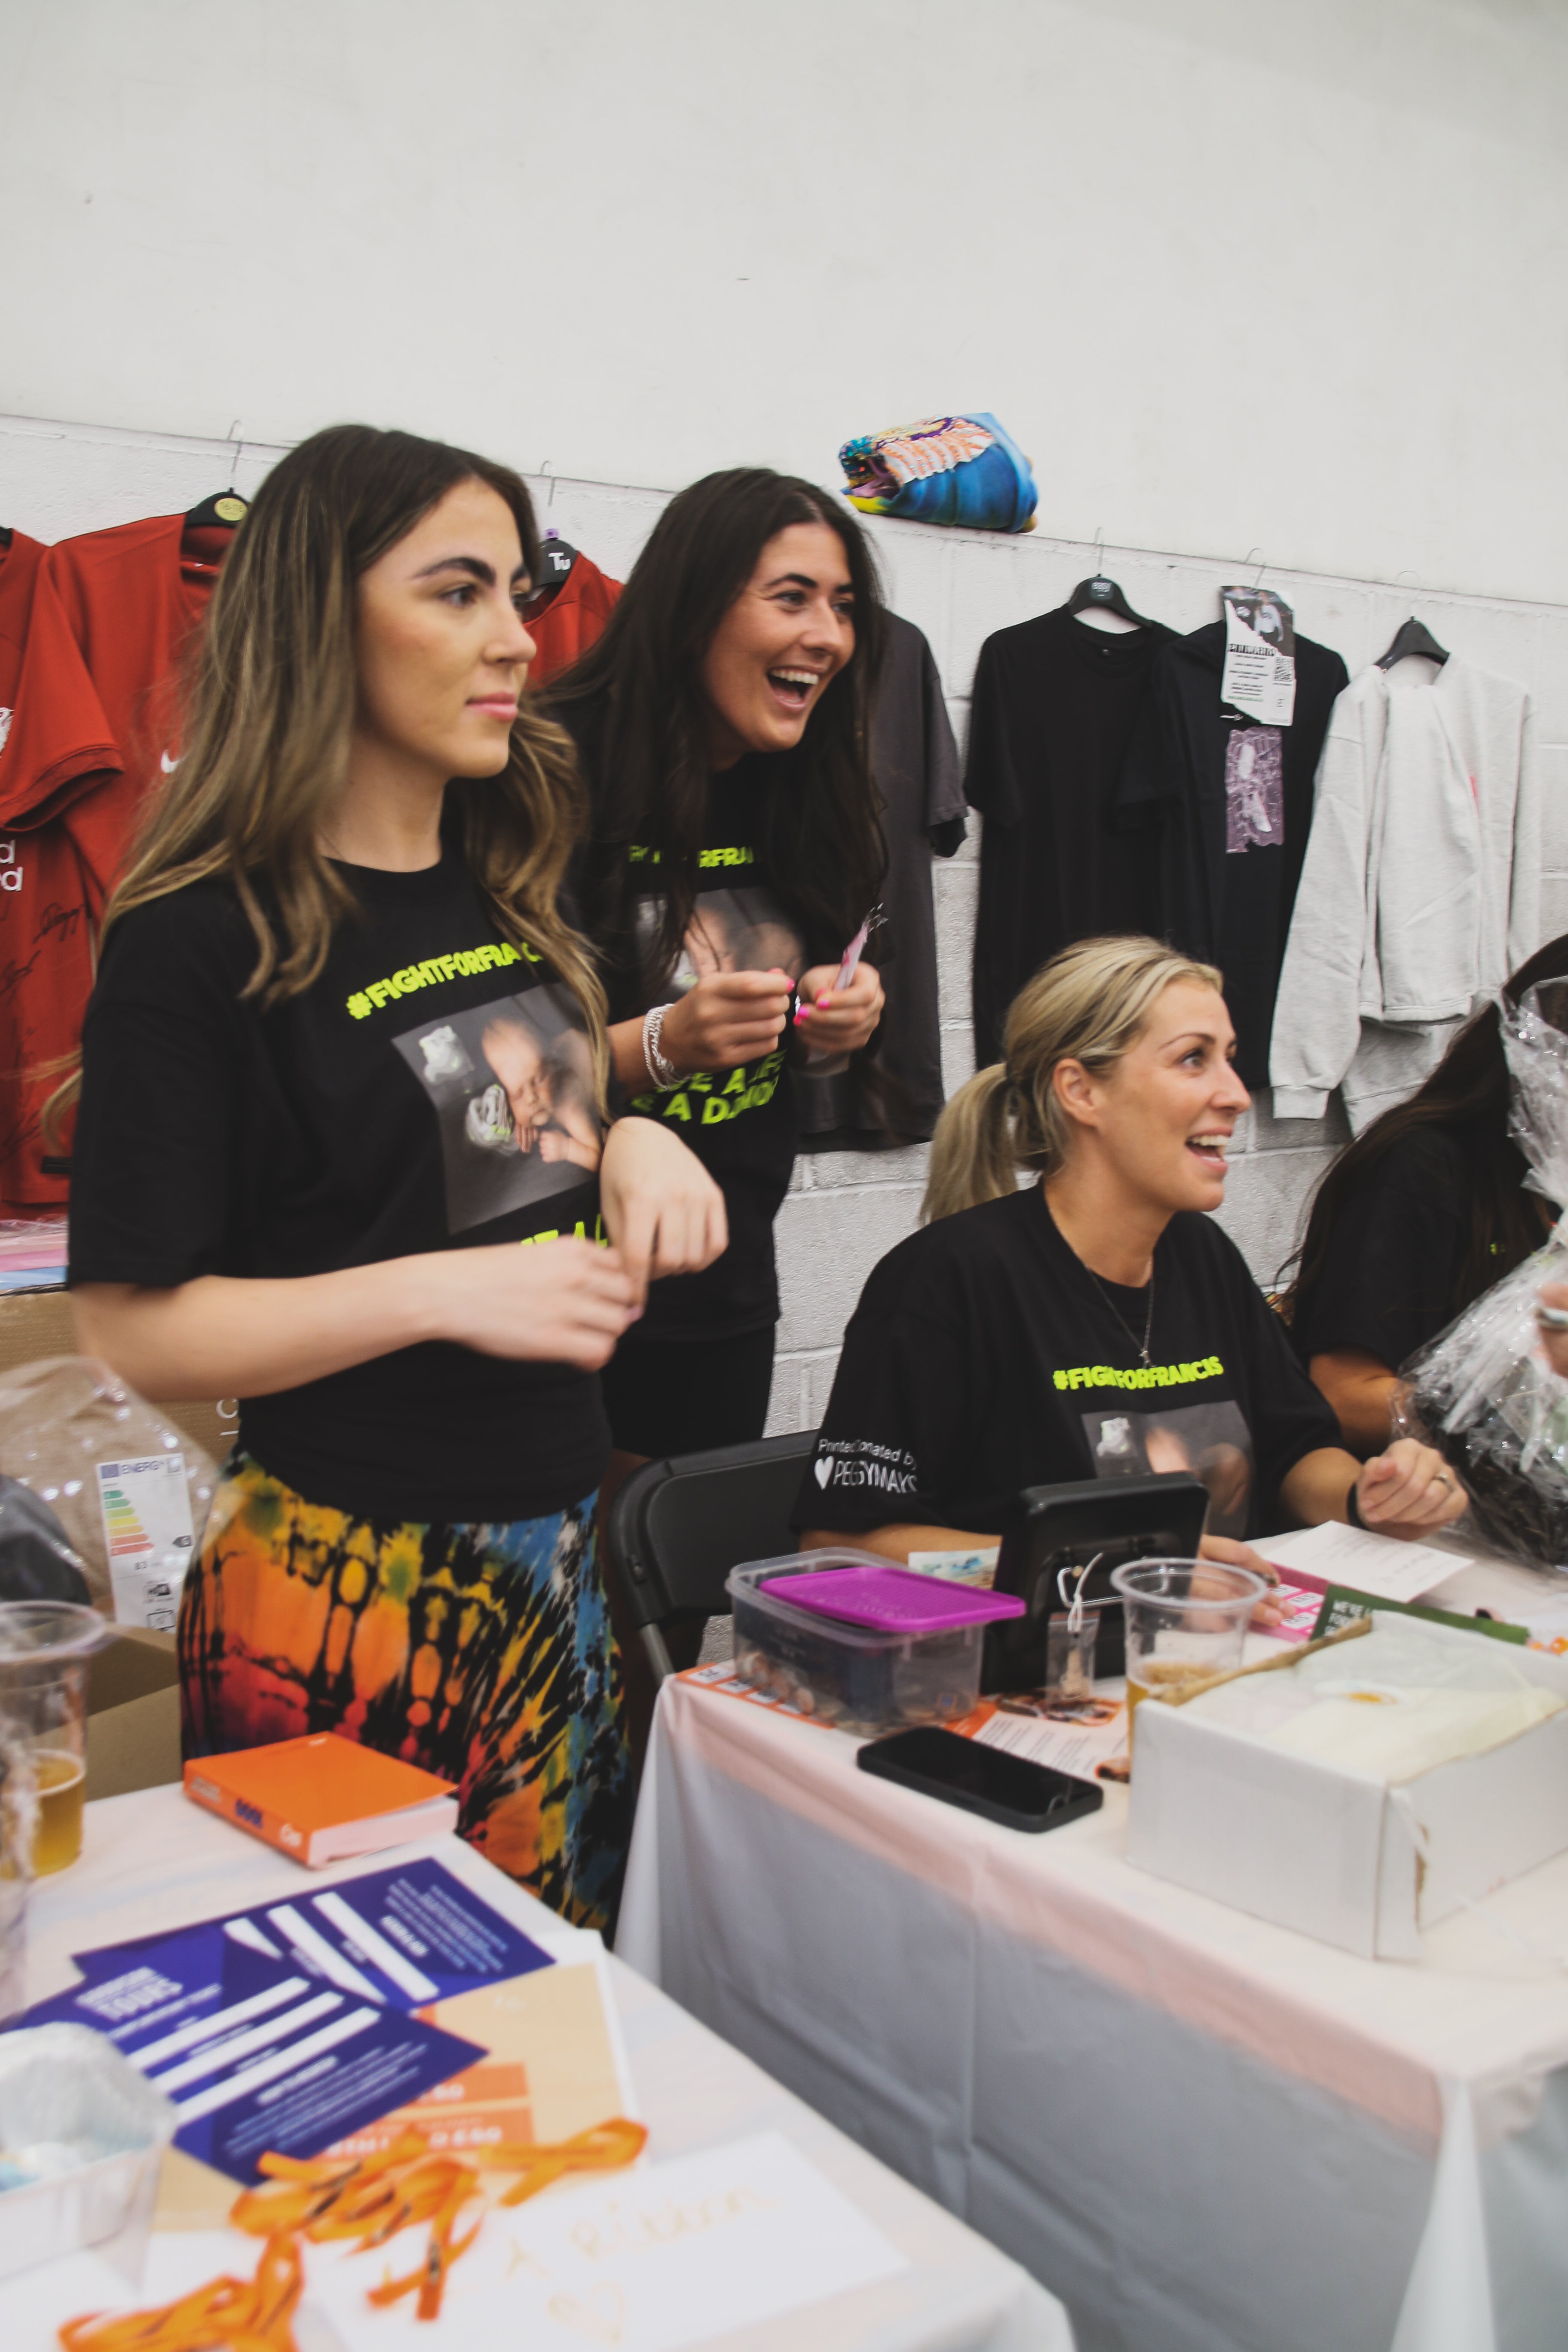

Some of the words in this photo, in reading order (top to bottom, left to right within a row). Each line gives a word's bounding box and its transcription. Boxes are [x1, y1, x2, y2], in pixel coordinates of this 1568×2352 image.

[548, 552, 571, 571] Tu
[720, 1068, 747, 1094] A
[662, 1092, 692, 1122] A
